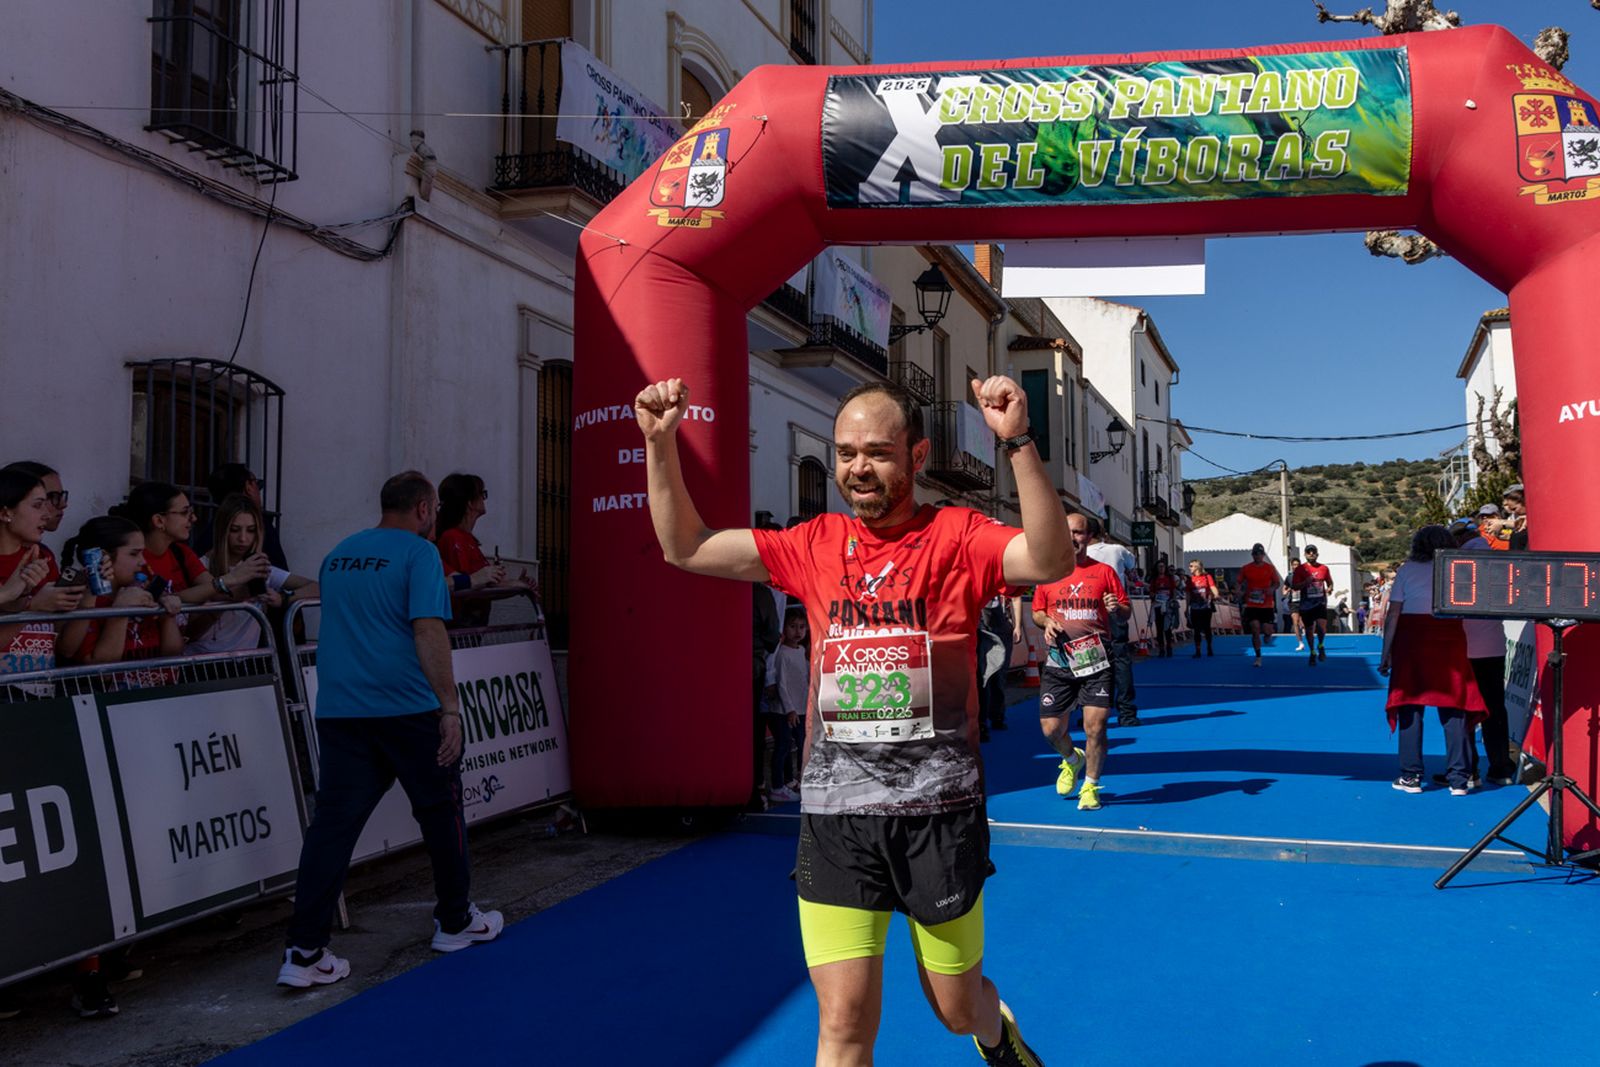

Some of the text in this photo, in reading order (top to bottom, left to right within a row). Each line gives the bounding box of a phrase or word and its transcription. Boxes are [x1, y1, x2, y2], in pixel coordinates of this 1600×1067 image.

[585, 63, 613, 95] CROSS
[882, 79, 928, 91] 2026
[937, 66, 1361, 126] CROSS PANTANO
[858, 75, 983, 204] X
[939, 126, 1350, 193] DEL VÍBORAS
[1547, 190, 1588, 202] MARTOS
[667, 217, 702, 227] MARTOS
[574, 404, 716, 432] AYUNTATO
[618, 448, 646, 465] DE
[592, 492, 651, 513] MART
[328, 556, 391, 572] STAFF
[1450, 559, 1600, 609] 01:17:
[10, 634, 54, 649] X CROS
[835, 643, 910, 664] X CROSS
[834, 661, 896, 677] PANTANO
[836, 671, 911, 711] 323
[457, 669, 549, 746] NOCASA
[836, 712, 860, 721] FRAN
[173, 731, 243, 792] JAÉN
[508, 736, 560, 762] NETWORK
[168, 805, 272, 864] MARTOS
